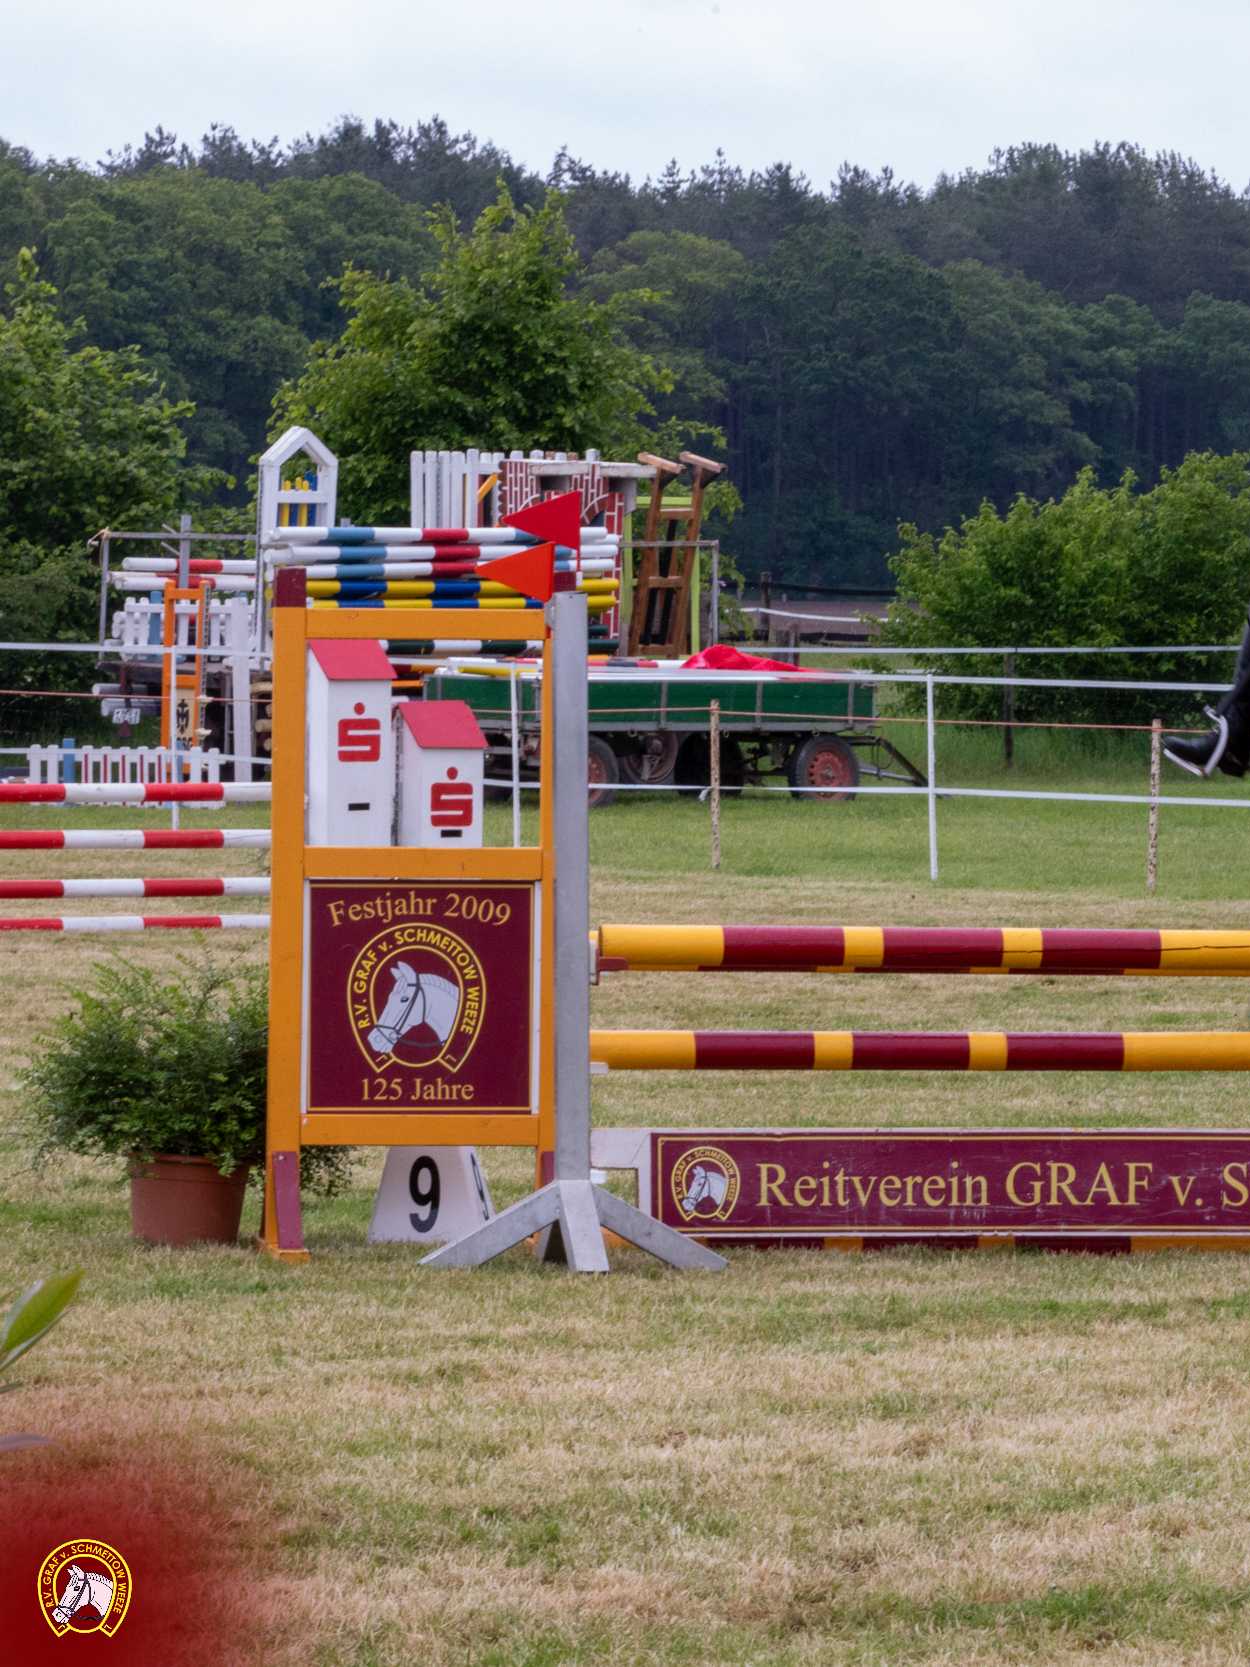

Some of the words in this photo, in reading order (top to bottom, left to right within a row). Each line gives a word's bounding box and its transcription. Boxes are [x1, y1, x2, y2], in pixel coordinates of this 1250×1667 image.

[327, 891, 437, 927] Festjahr
[444, 893, 512, 926] 2009
[353, 950, 378, 994] GRAF
[395, 929, 479, 981] SCHMETTOW
[460, 985, 480, 1035] WEEZE
[361, 1078, 402, 1101] 125
[411, 1078, 475, 1101] Jahre
[409, 1155, 440, 1233] 9
[755, 1160, 991, 1208] Reitverein
[1005, 1161, 1154, 1207] GRAF
[1169, 1174, 1204, 1208] v.
